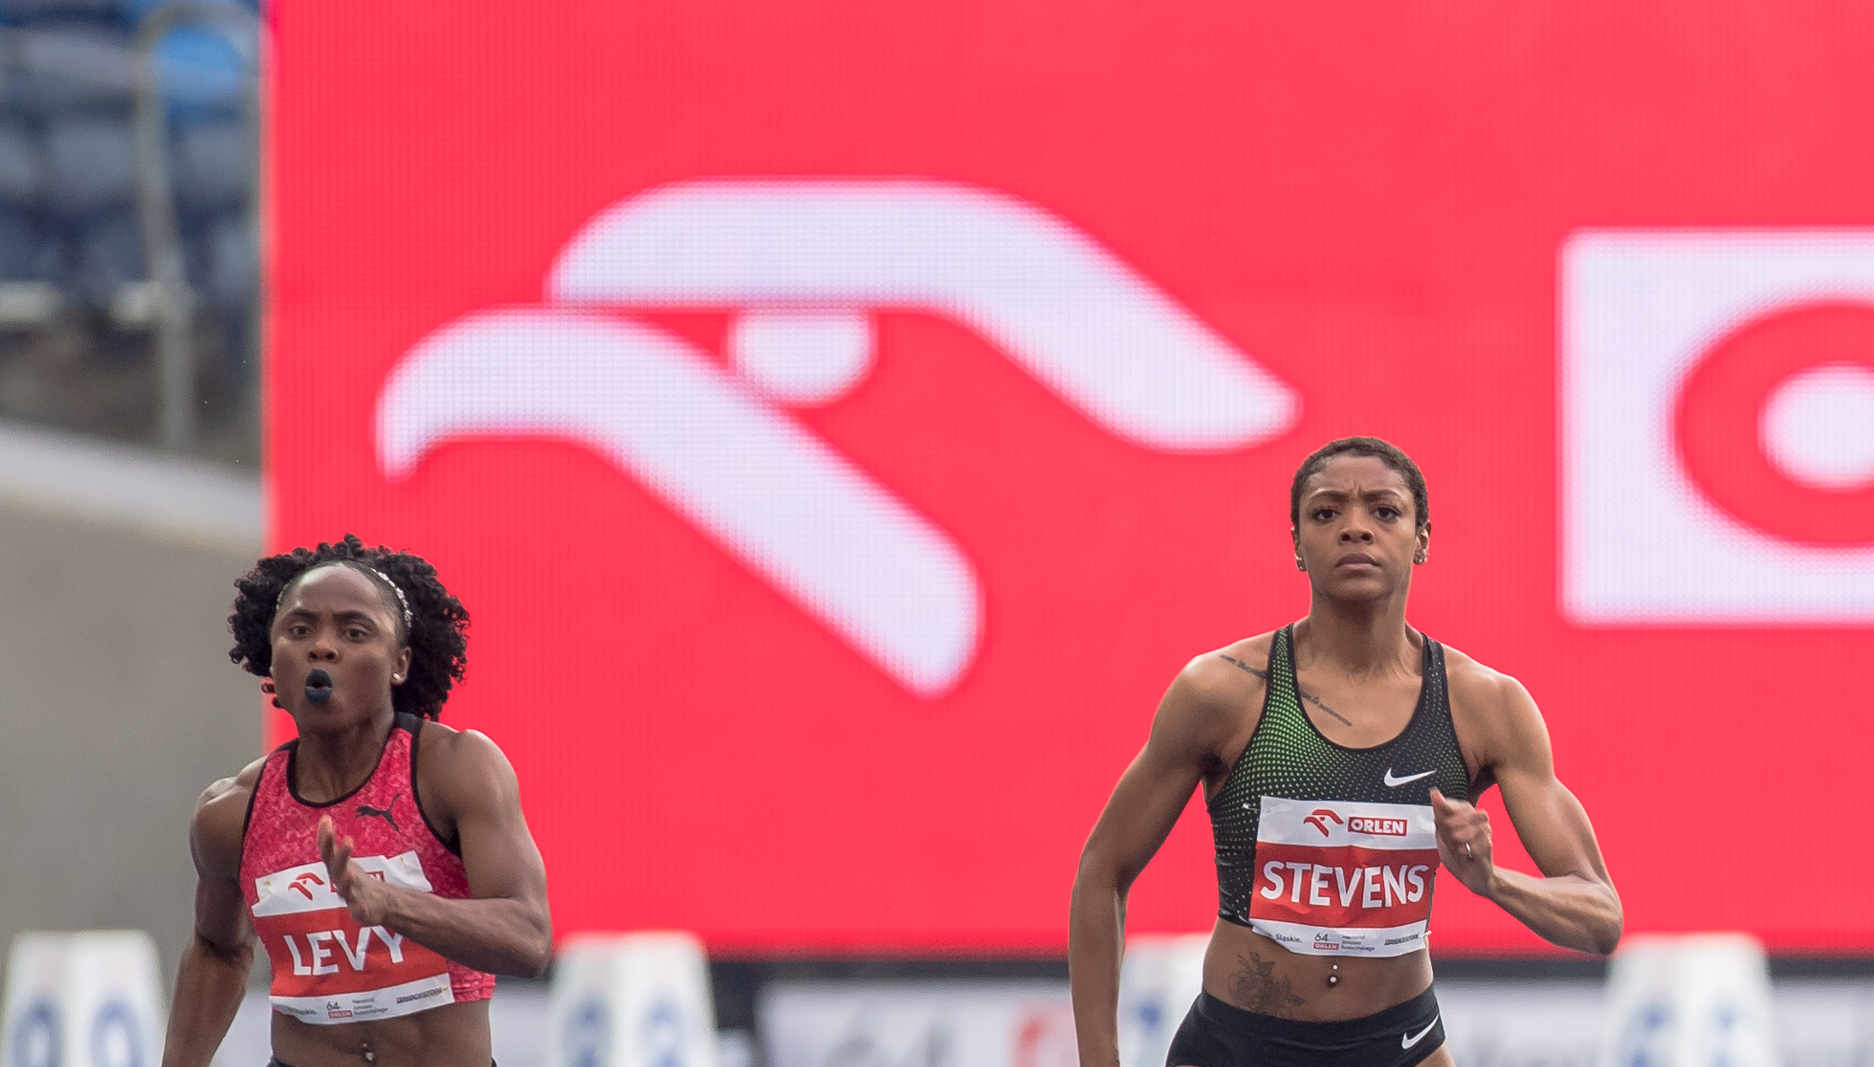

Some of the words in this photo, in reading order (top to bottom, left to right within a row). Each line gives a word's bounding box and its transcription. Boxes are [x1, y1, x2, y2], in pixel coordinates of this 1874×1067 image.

[1350, 819, 1404, 834] ORLEN
[1260, 860, 1429, 909] STEVENS
[283, 925, 404, 976] LEVY
